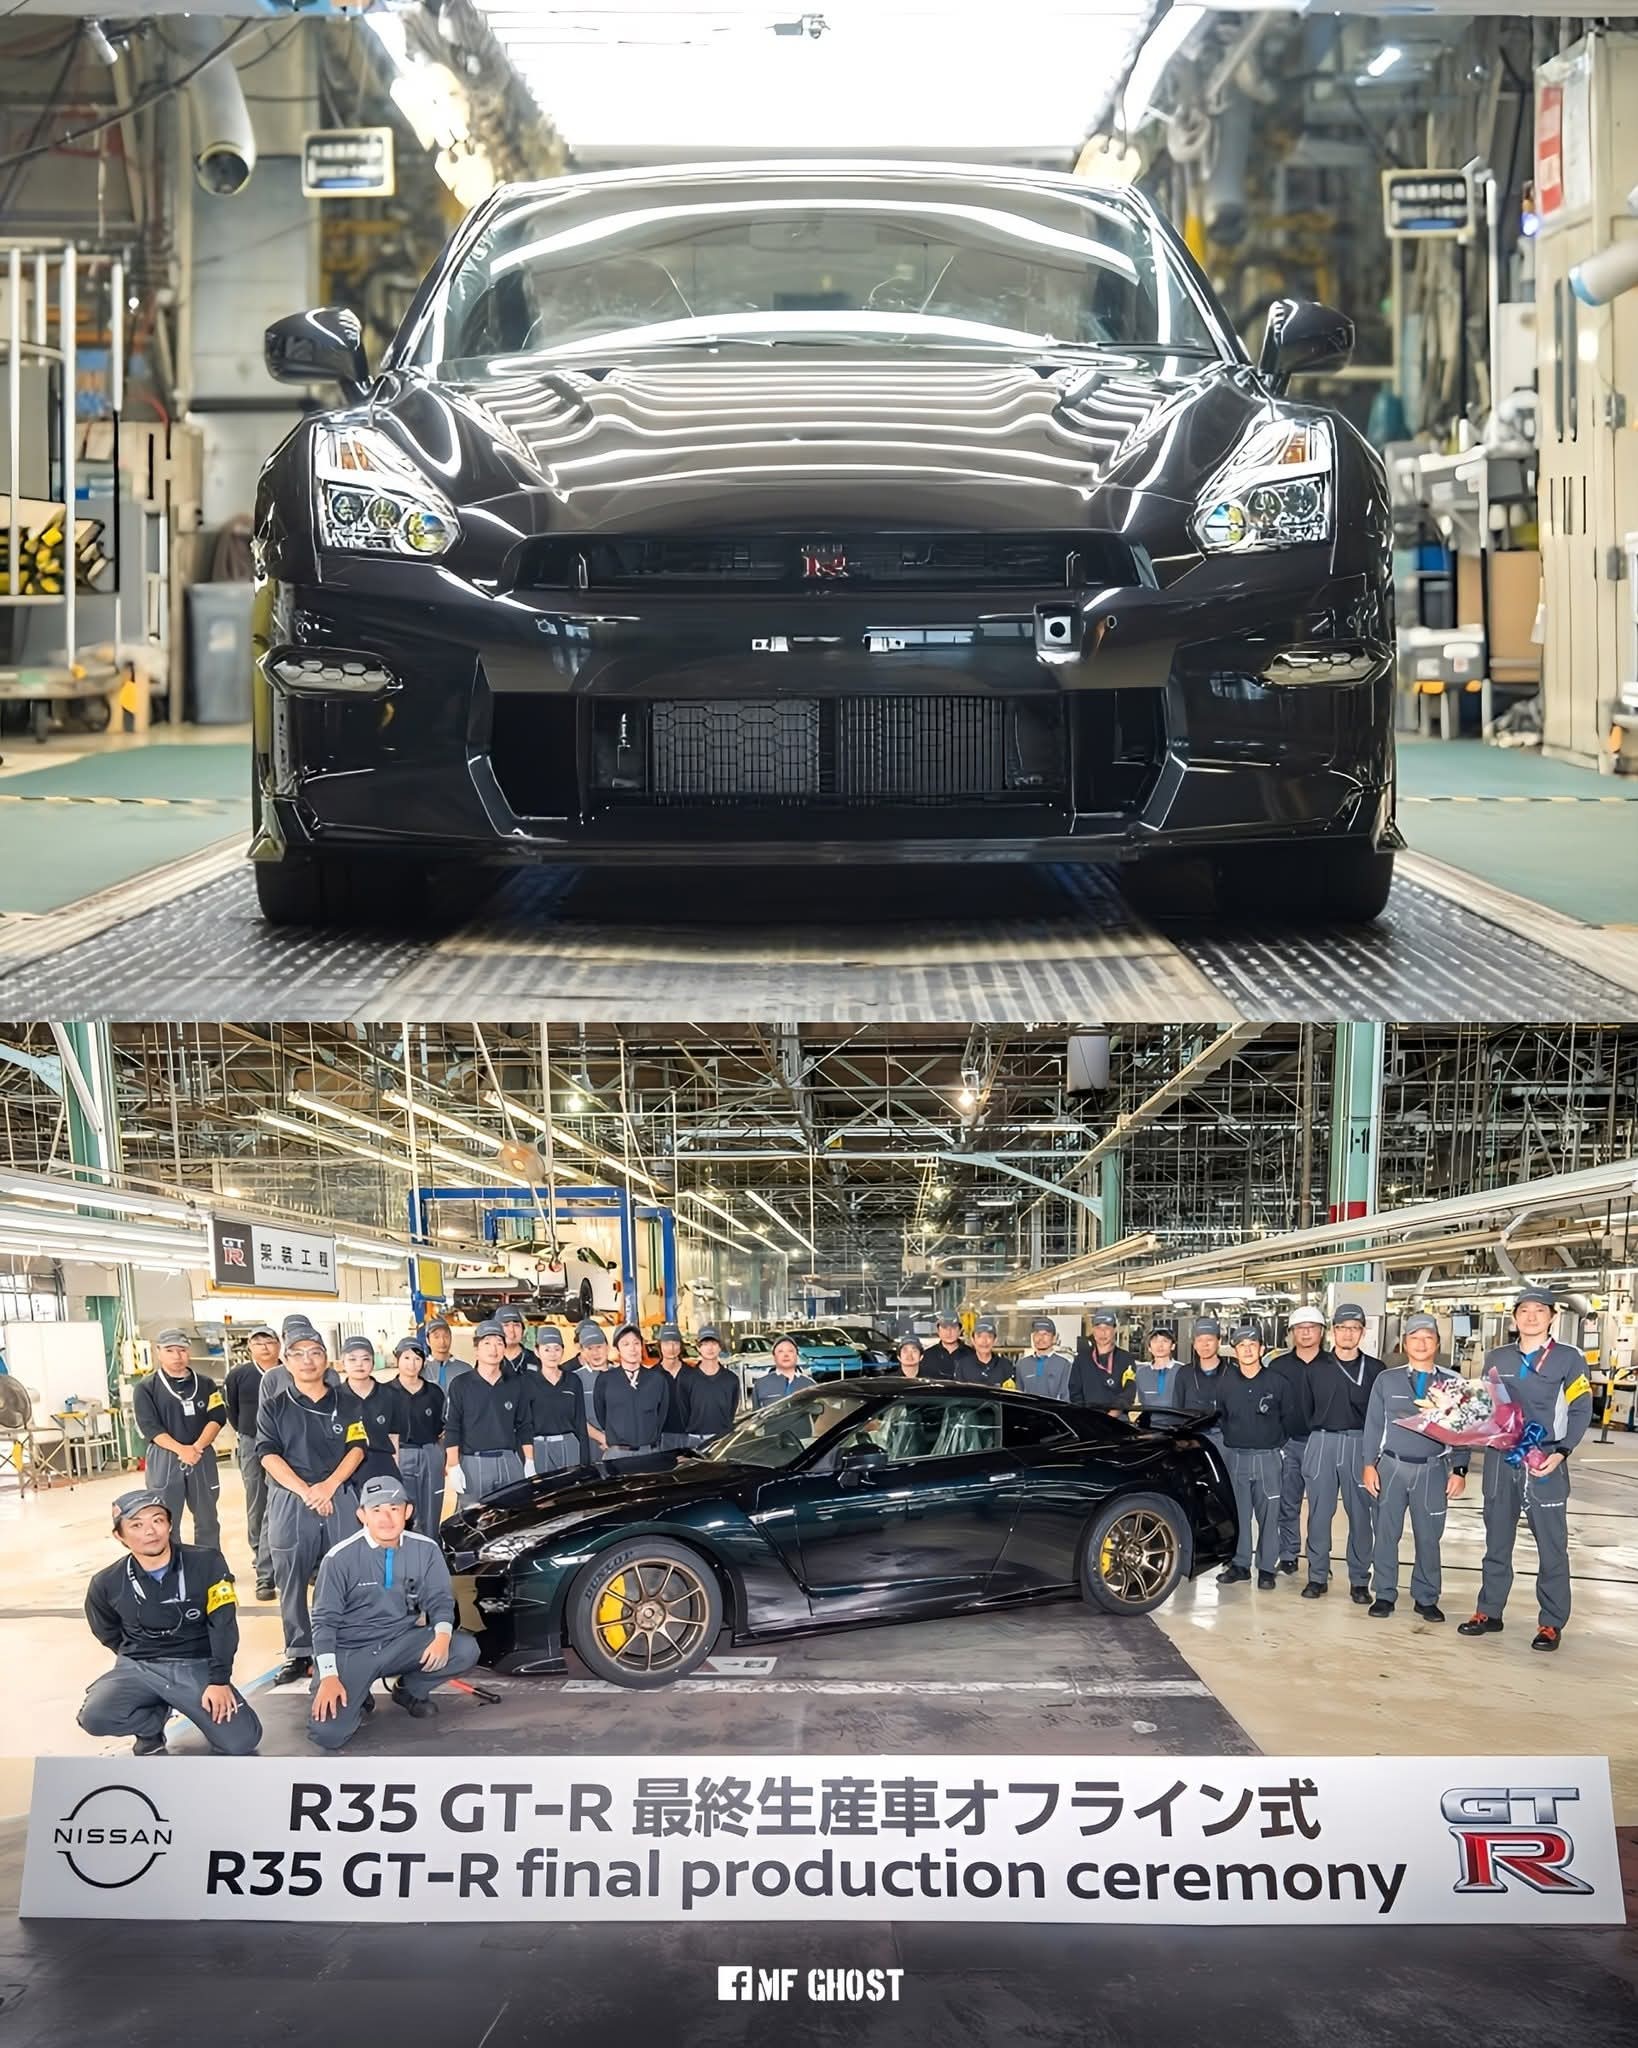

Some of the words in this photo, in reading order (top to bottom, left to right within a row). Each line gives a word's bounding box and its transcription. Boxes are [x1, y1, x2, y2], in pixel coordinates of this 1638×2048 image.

[54, 1828, 172, 1845] NISSAN
[290, 1783, 417, 1832] R35
[440, 1783, 613, 1833] GT-R
[632, 1776, 1322, 1840] 最終生産車オフライン式
[206, 1850, 323, 1897] R35
[343, 1852, 500, 1898] GT-R
[516, 1848, 660, 1898] final
[682, 1848, 1046, 1911] production
[1066, 1862, 1408, 1914] ceremony
